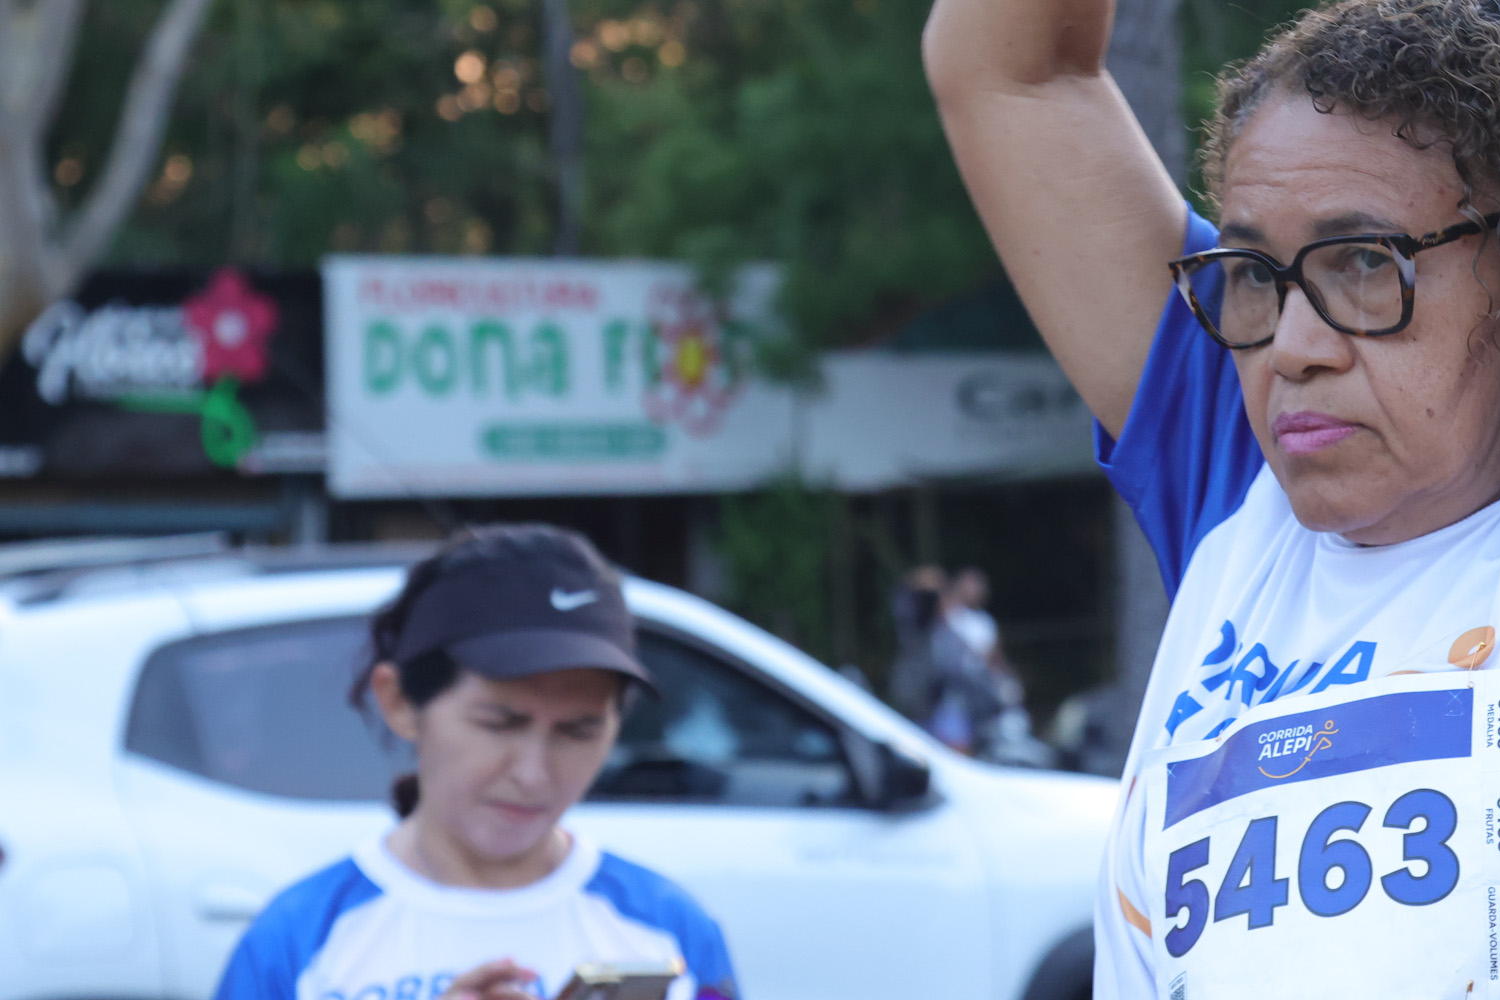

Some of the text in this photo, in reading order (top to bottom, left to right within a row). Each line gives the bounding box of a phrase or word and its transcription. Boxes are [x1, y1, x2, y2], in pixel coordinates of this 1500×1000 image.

[1257, 724, 1314, 744] CORRIDA
[1485, 702, 1495, 749] MEDALHA
[1257, 735, 1313, 761] ALEPI
[1485, 808, 1494, 846] FRUTAS
[1164, 788, 1461, 958] 5463
[1487, 886, 1499, 981] GUARDA-VOLUMES
